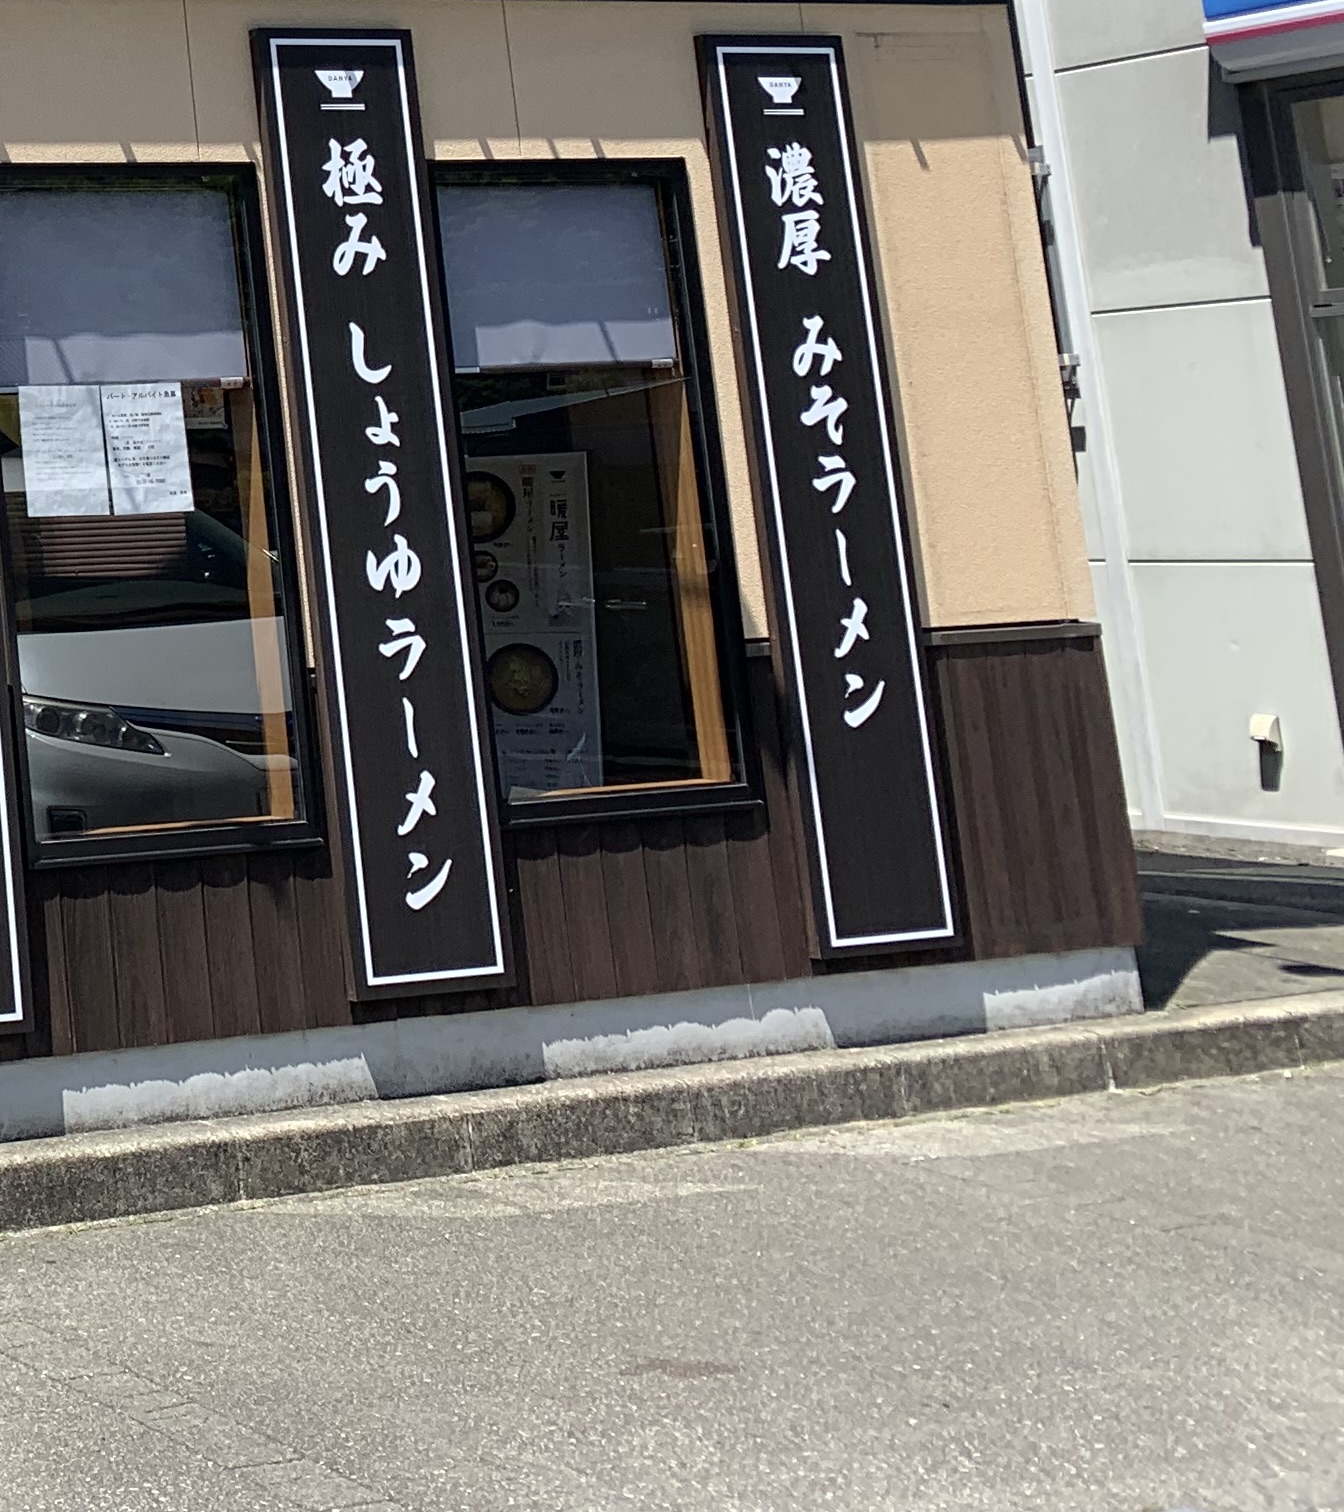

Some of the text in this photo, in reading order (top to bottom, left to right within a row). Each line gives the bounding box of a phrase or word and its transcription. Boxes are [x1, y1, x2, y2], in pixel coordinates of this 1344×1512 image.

[321, 138, 453, 911] 極み しょうゆラーメン
[549, 498, 570, 542] 暖屋
[764, 141, 886, 729] 濃厚 みそラーメン
